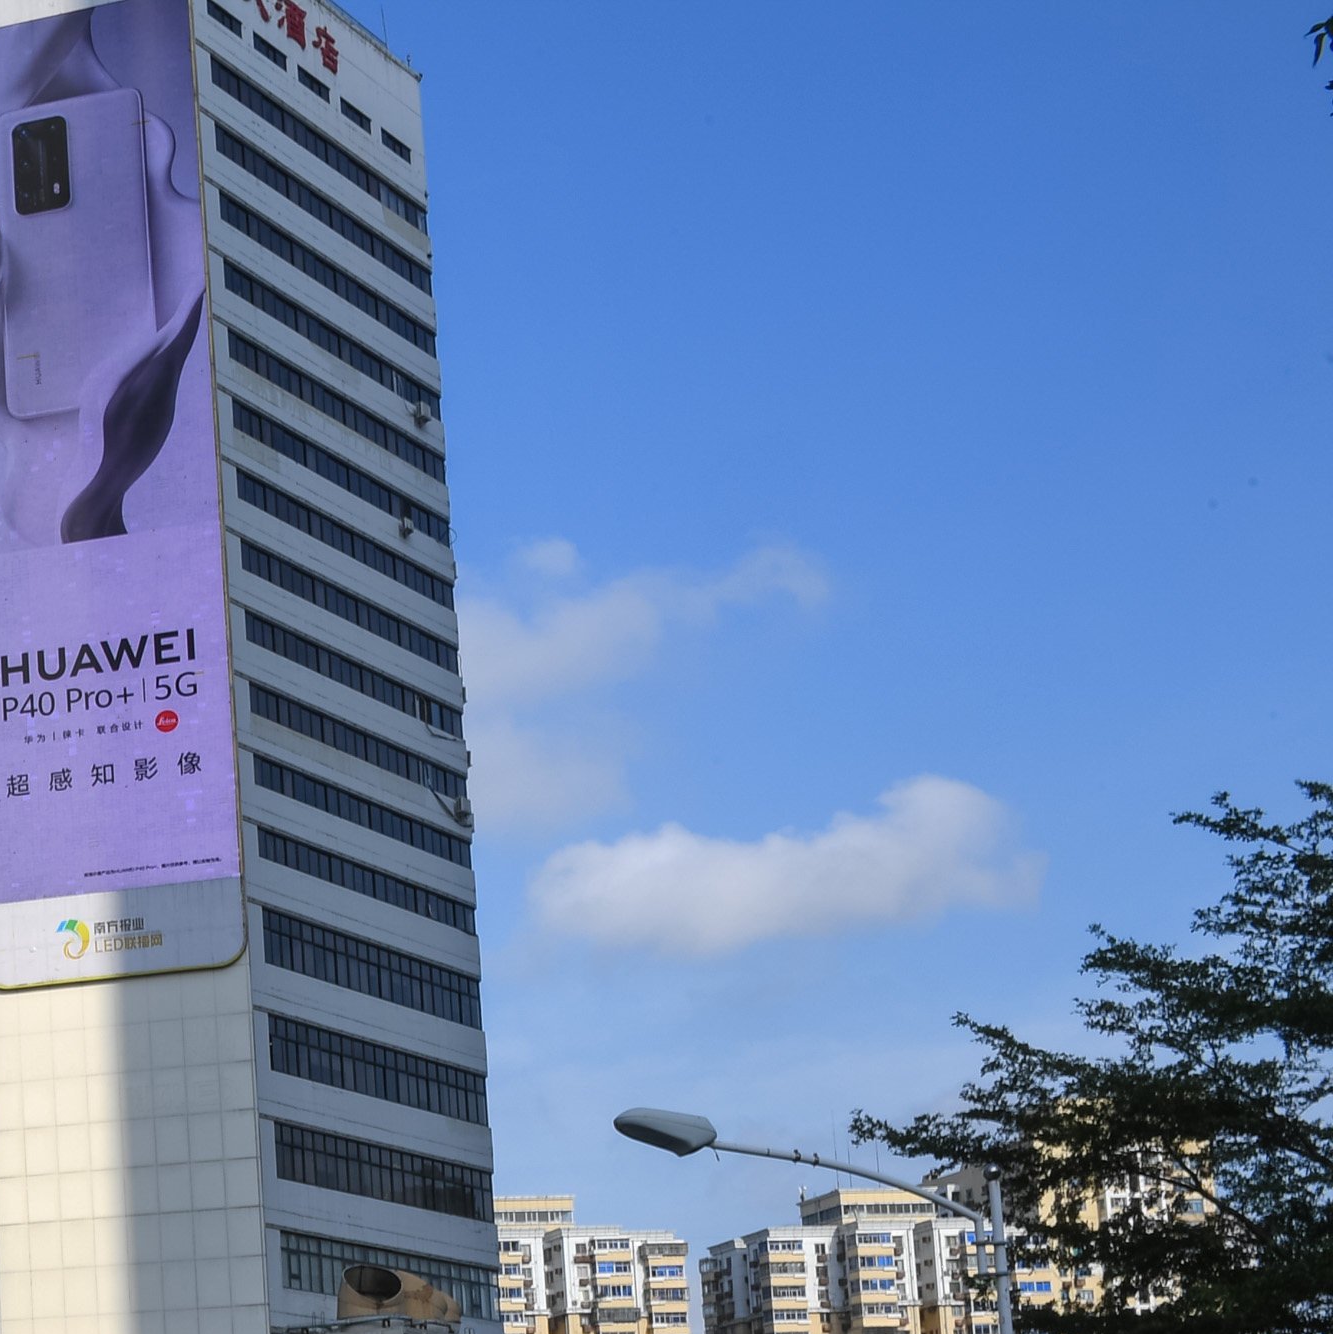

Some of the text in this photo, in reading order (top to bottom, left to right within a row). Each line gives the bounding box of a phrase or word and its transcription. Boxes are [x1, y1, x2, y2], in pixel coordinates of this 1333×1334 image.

[0, 628, 197, 688] HUAWEI
[2, 691, 55, 722] P40
[155, 671, 199, 701] 5G
[6, 751, 202, 798] 超感知影像
